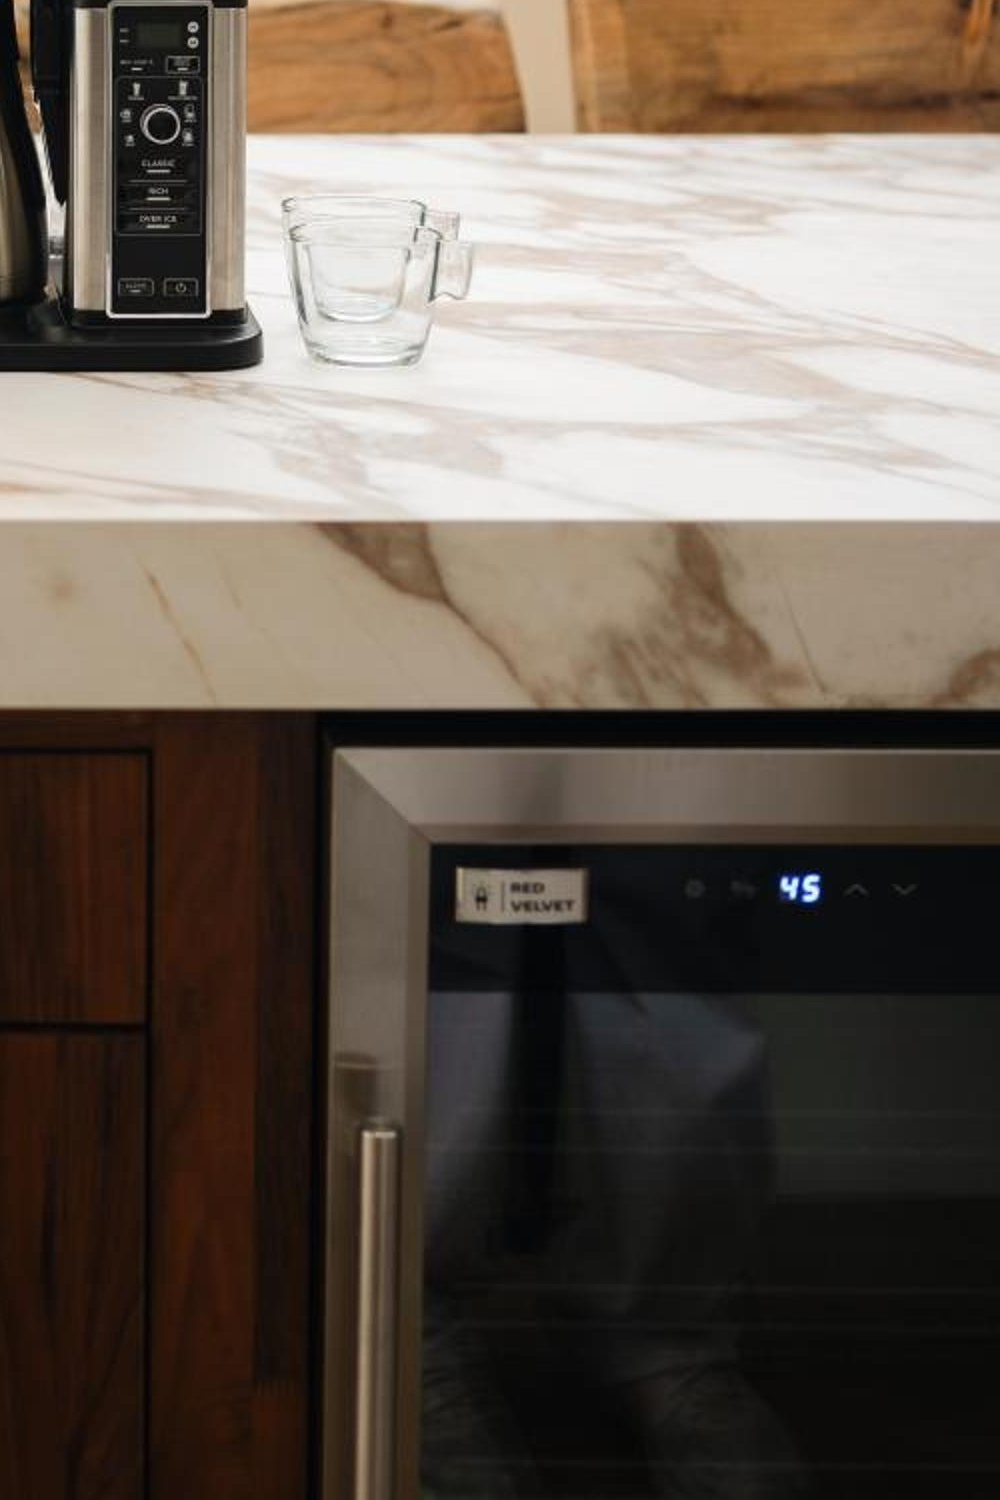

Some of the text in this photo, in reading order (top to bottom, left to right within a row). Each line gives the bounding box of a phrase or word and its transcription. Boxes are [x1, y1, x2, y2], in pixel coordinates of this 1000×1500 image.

[510, 882, 545, 894] RED
[780, 874, 821, 902] 45
[510, 900, 574, 912] VELVET
